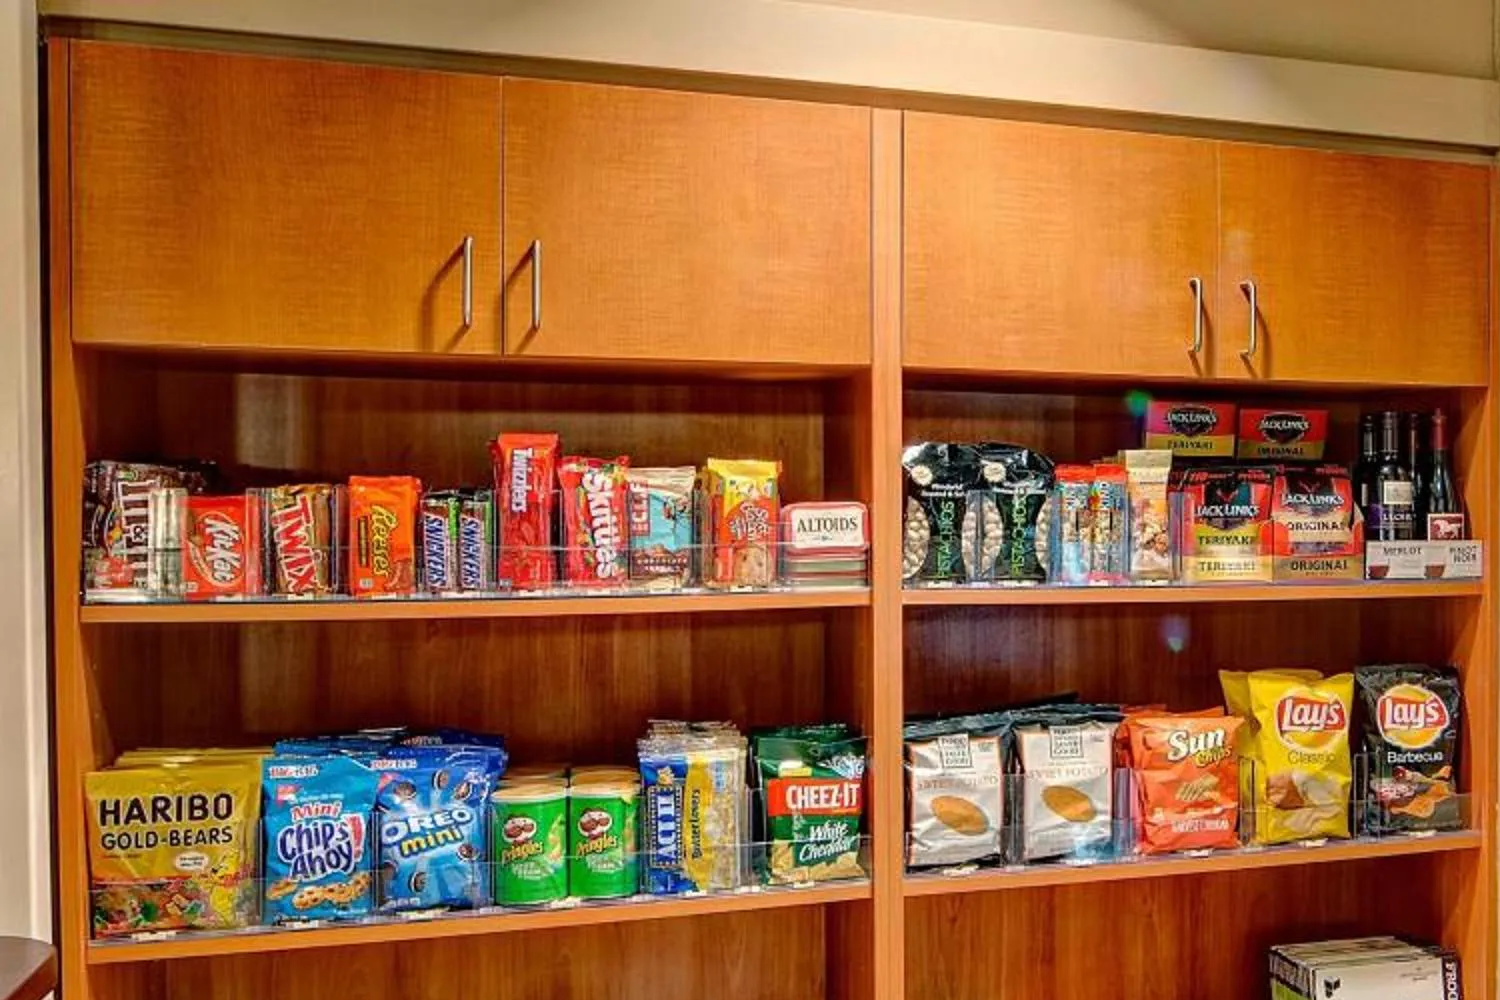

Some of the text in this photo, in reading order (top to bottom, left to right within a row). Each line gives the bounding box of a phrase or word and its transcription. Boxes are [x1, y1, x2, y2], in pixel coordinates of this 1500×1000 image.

[582, 468, 616, 579] Skittles
[796, 516, 859, 533] ALTOIDS
[273, 496, 318, 593] TWIX
[1281, 697, 1342, 733] Lay's
[1382, 696, 1440, 732] Lay's
[1167, 728, 1226, 762] Sun
[1387, 751, 1444, 764] Barbecue
[99, 792, 235, 830] HARIBO
[785, 782, 862, 809] CHEEZ-IT
[100, 825, 234, 851] GOLD-BEARS
[280, 820, 350, 858] Chips
[380, 807, 472, 845] OREO
[400, 826, 463, 856] mini
[809, 820, 849, 842] White
[575, 834, 618, 856] Pringles
